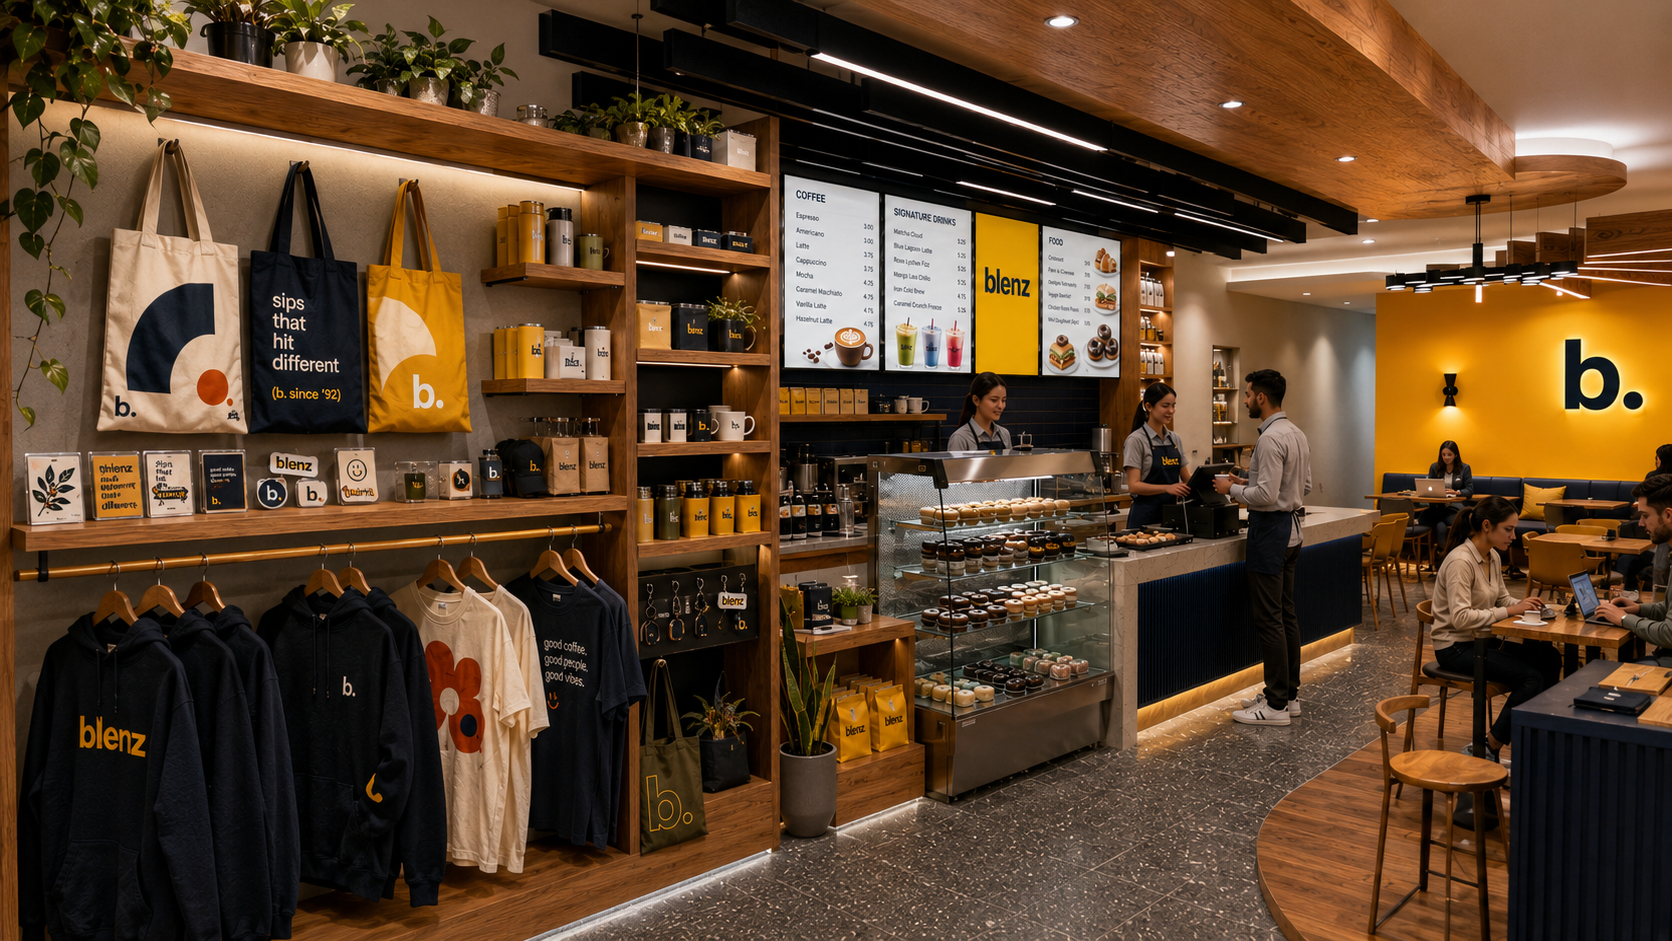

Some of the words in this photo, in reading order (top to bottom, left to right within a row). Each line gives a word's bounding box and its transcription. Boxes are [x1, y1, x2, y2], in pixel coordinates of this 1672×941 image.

[796, 190, 826, 203] COFFEE
[894, 208, 932, 222] SIGNATURE
[933, 215, 956, 226] DRINKS
[796, 227, 825, 237] Americano
[796, 242, 810, 250] Latte
[1049, 237, 1063, 246] FOOD
[796, 256, 827, 266] Cappuccino
[796, 271, 813, 279] Mocha
[985, 266, 1030, 297] blenz
[272, 292, 305, 313] sips
[272, 312, 306, 331] that
[273, 333, 294, 350] hit
[272, 354, 340, 373] different
[1565, 339, 1643, 410] b.
[272, 386, 287, 401] (b.
[289, 388, 319, 399] since
[321, 388, 341, 402] '92)
[413, 374, 444, 409] b.
[115, 395, 137, 417] b.
[698, 421, 709, 430] b.
[276, 456, 313, 472] blenz
[489, 466, 500, 478] b.
[530, 460, 541, 472] b.
[559, 462, 576, 471] blenz
[589, 461, 606, 469] blenz
[212, 496, 221, 505] b.
[266, 485, 282, 501] b.
[306, 486, 324, 502] b.
[543, 639, 562, 651] good
[563, 642, 587, 656] coffee.
[544, 655, 563, 667] good
[563, 658, 588, 672] people.
[342, 675, 356, 697] b.
[545, 671, 563, 683] good
[565, 673, 585, 687] vibes.
[885, 715, 903, 726] blenz
[79, 715, 146, 758] blenz
[845, 725, 866, 737] blenz
[646, 775, 693, 832] b.
